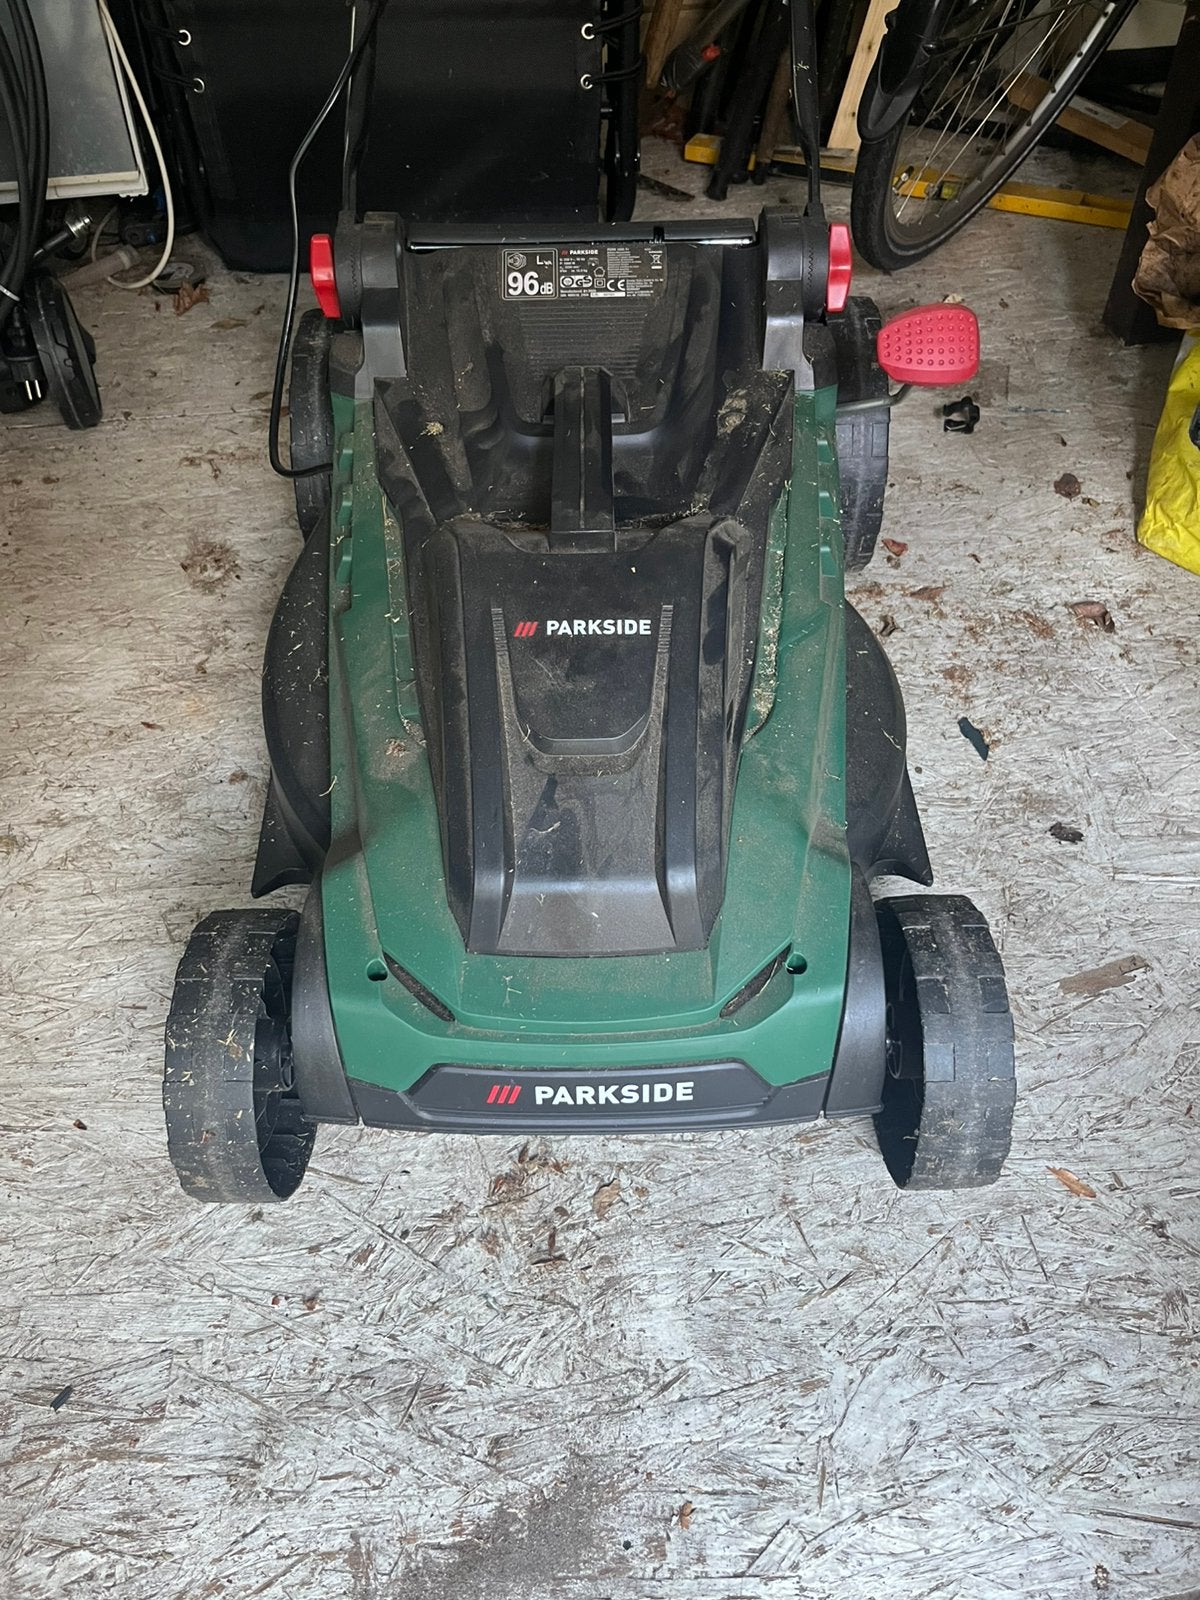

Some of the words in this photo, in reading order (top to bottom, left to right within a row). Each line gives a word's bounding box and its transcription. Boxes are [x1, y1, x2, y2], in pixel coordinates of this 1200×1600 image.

[507, 271, 540, 296] 96
[540, 281, 554, 295] dB
[606, 279, 626, 291] CE
[546, 619, 652, 636] PARKSIDE
[534, 1081, 695, 1105] PARKSIDE
